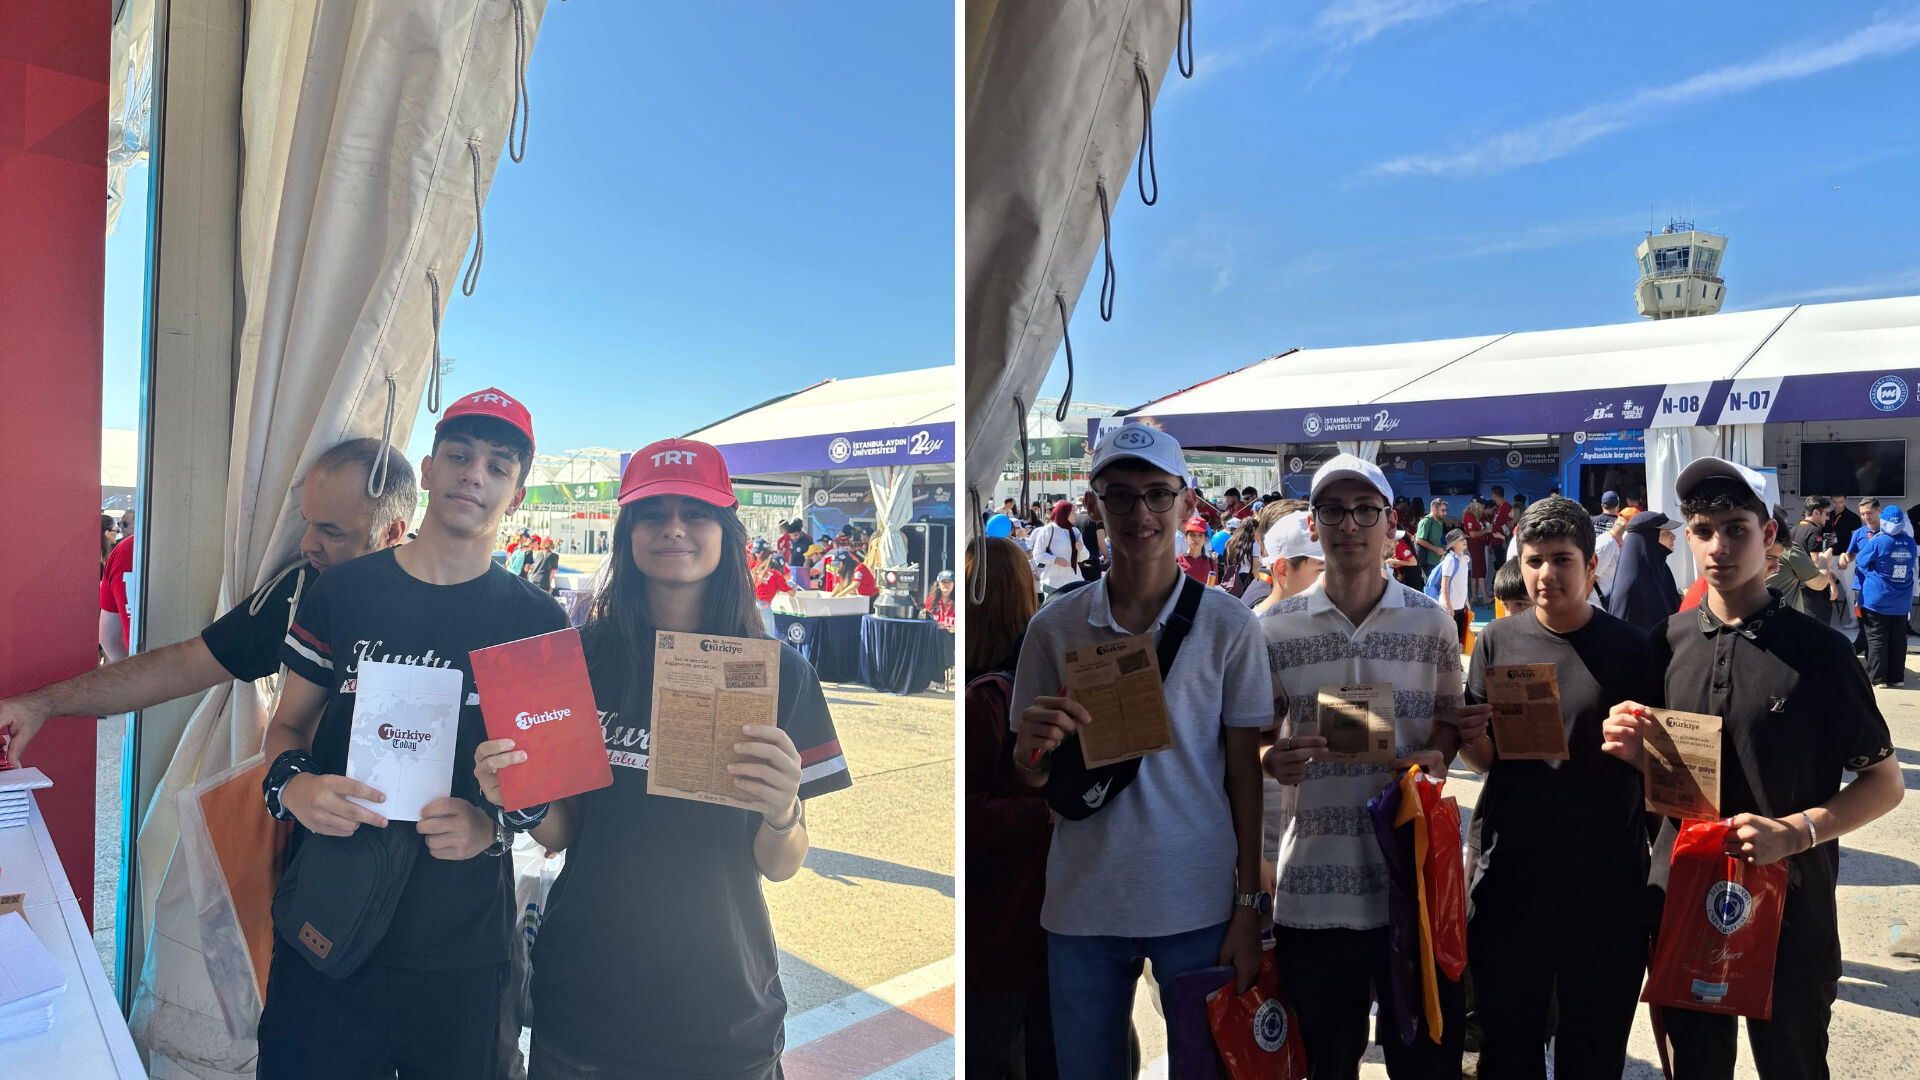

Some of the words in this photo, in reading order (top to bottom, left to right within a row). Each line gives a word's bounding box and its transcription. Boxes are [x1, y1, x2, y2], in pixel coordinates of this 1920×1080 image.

[471, 393, 512, 407] TRT
[1662, 396, 1700, 414] N-08
[1730, 390, 1771, 411] N-07
[1324, 423, 1362, 431] ÜNİVERSİTESİ
[852, 440, 885, 450] İSTANBUL
[885, 438, 907, 446] AYDIN
[852, 446, 897, 457] ÜNİVERSİTESİ
[651, 450, 697, 467] TRT
[764, 494, 787, 505] TARIM
[699, 639, 743, 654] Türkiye
[515, 708, 571, 730] Türkiye
[1665, 716, 1700, 731] Türkiye
[378, 723, 432, 743] Türkiye
[392, 739, 418, 751] Today
[1081, 781, 1102, 804] NIKE
